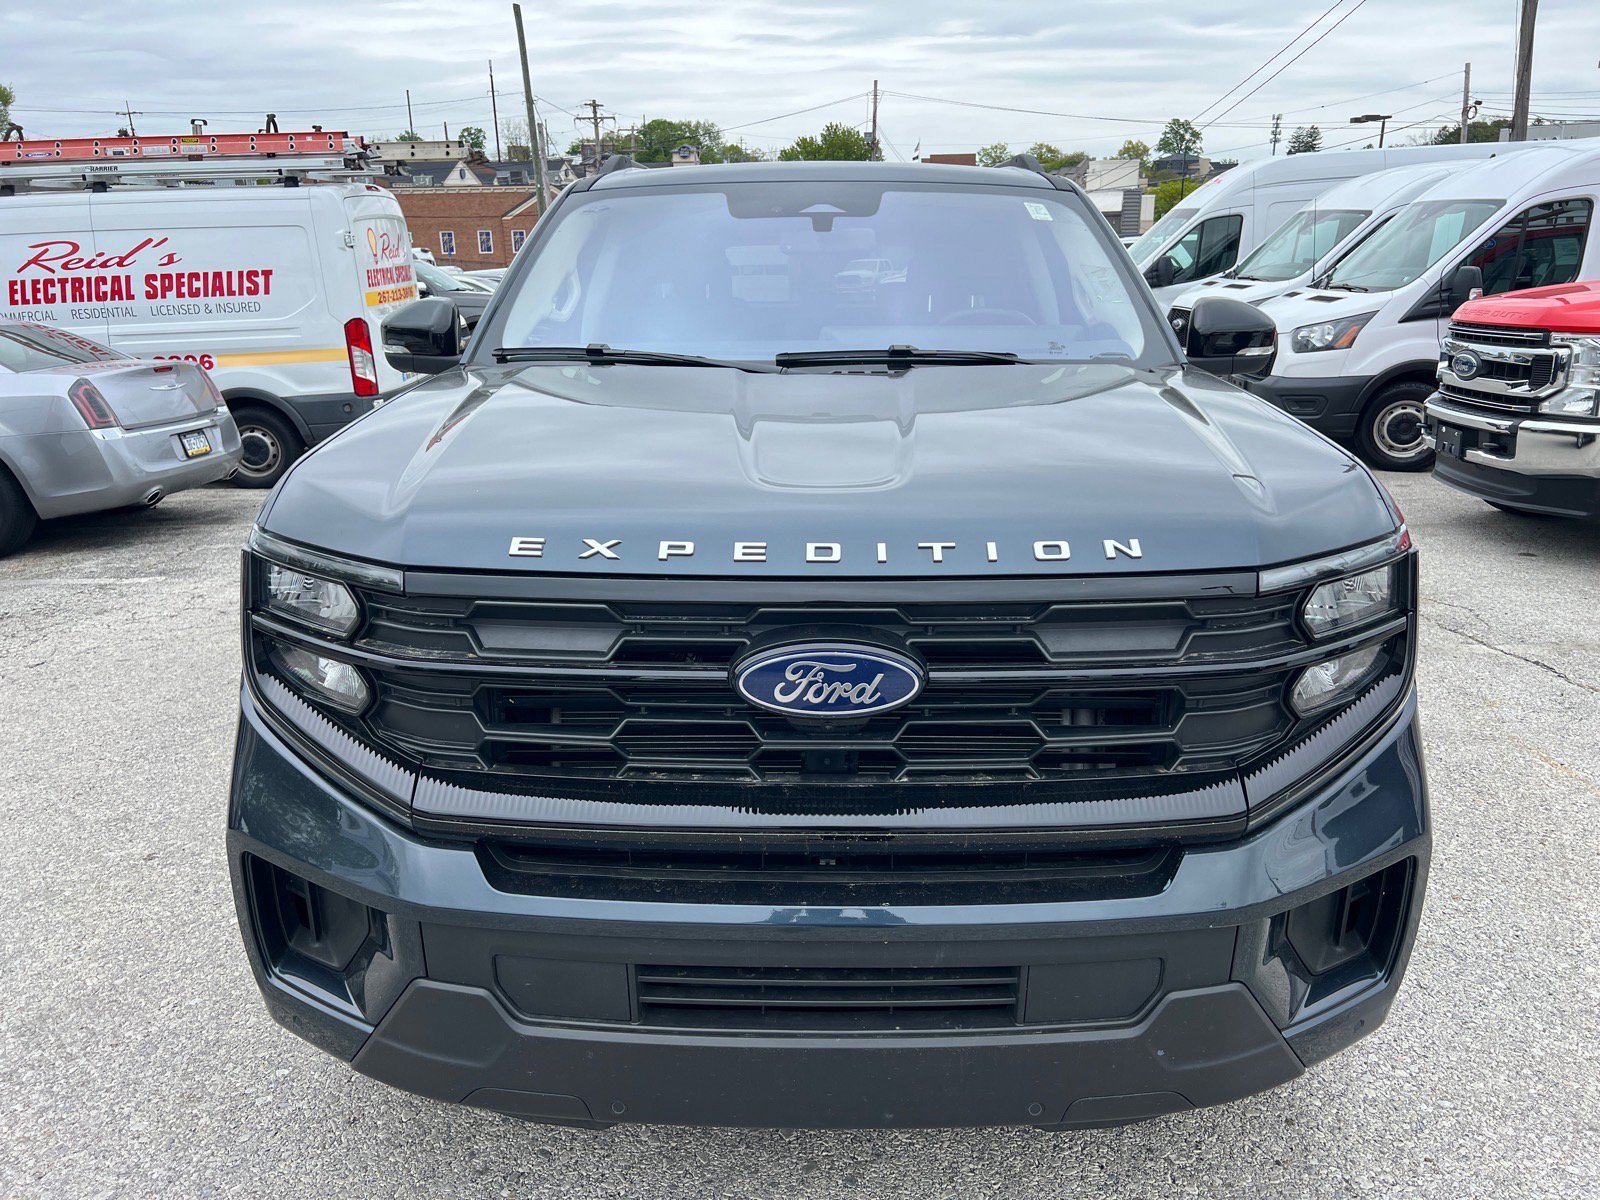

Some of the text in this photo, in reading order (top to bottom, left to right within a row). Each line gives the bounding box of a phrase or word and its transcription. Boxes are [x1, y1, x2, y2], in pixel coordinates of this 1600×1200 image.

[17, 237, 182, 274] Reid's
[380, 233, 406, 260] Reid's
[9, 269, 273, 306] ELECTRICAL SPECIALIST
[71, 306, 137, 320] RESIDENTIAL
[150, 303, 201, 317] LICENSED
[204, 303, 212, 315] &
[215, 301, 261, 314] INSURED
[508, 536, 1143, 563] EXPEDITION
[773, 660, 885, 705] Ford
